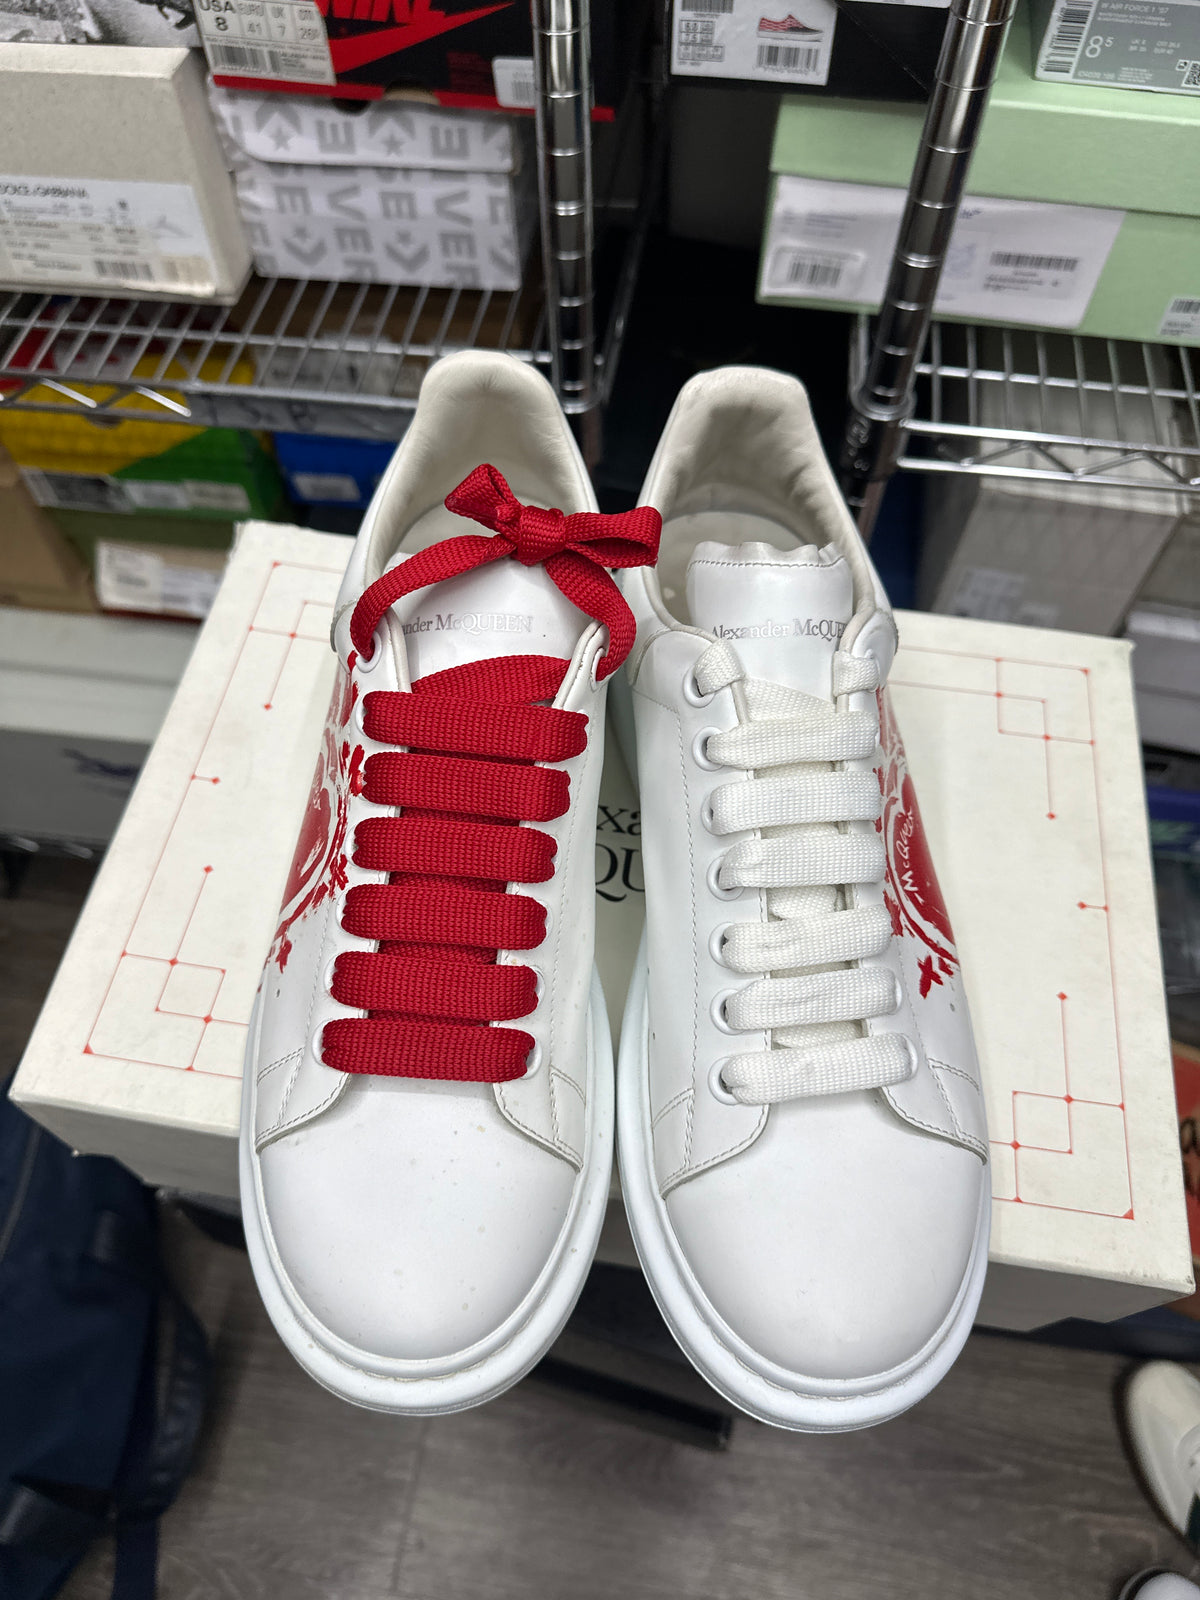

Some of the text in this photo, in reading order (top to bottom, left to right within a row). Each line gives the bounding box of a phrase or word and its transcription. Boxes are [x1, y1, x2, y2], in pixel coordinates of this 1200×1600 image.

[200, 0, 236, 13] USA
[215, 17, 228, 31] 8
[434, 613, 534, 635] McQUEEN
[712, 620, 790, 640] Alexander
